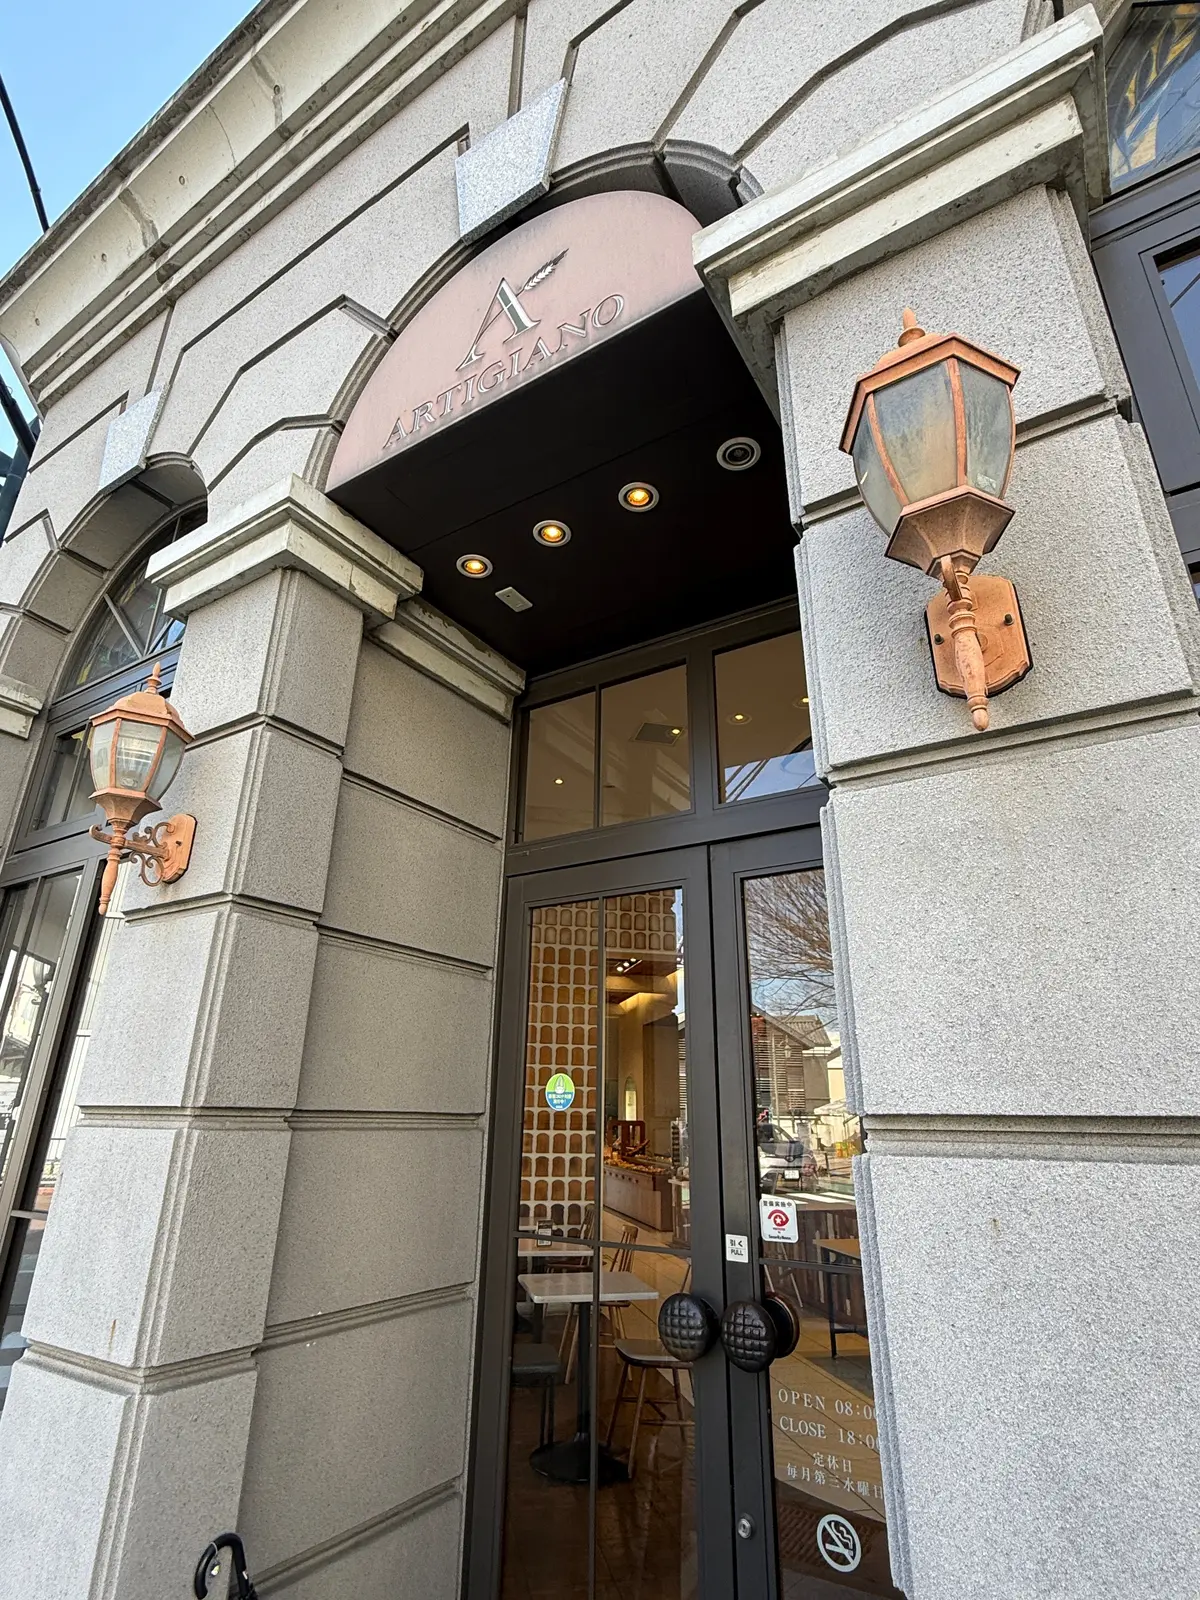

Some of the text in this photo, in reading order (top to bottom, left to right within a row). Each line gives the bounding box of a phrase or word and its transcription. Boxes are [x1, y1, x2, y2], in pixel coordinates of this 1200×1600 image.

[382, 293, 625, 450] ARTIGIANO
[729, 1239, 743, 1247] 引く
[730, 1248, 744, 1256] PULL
[778, 1388, 826, 1411] OPEN
[779, 1415, 827, 1440] CLOSE
[812, 1451, 853, 1474] 定休日
